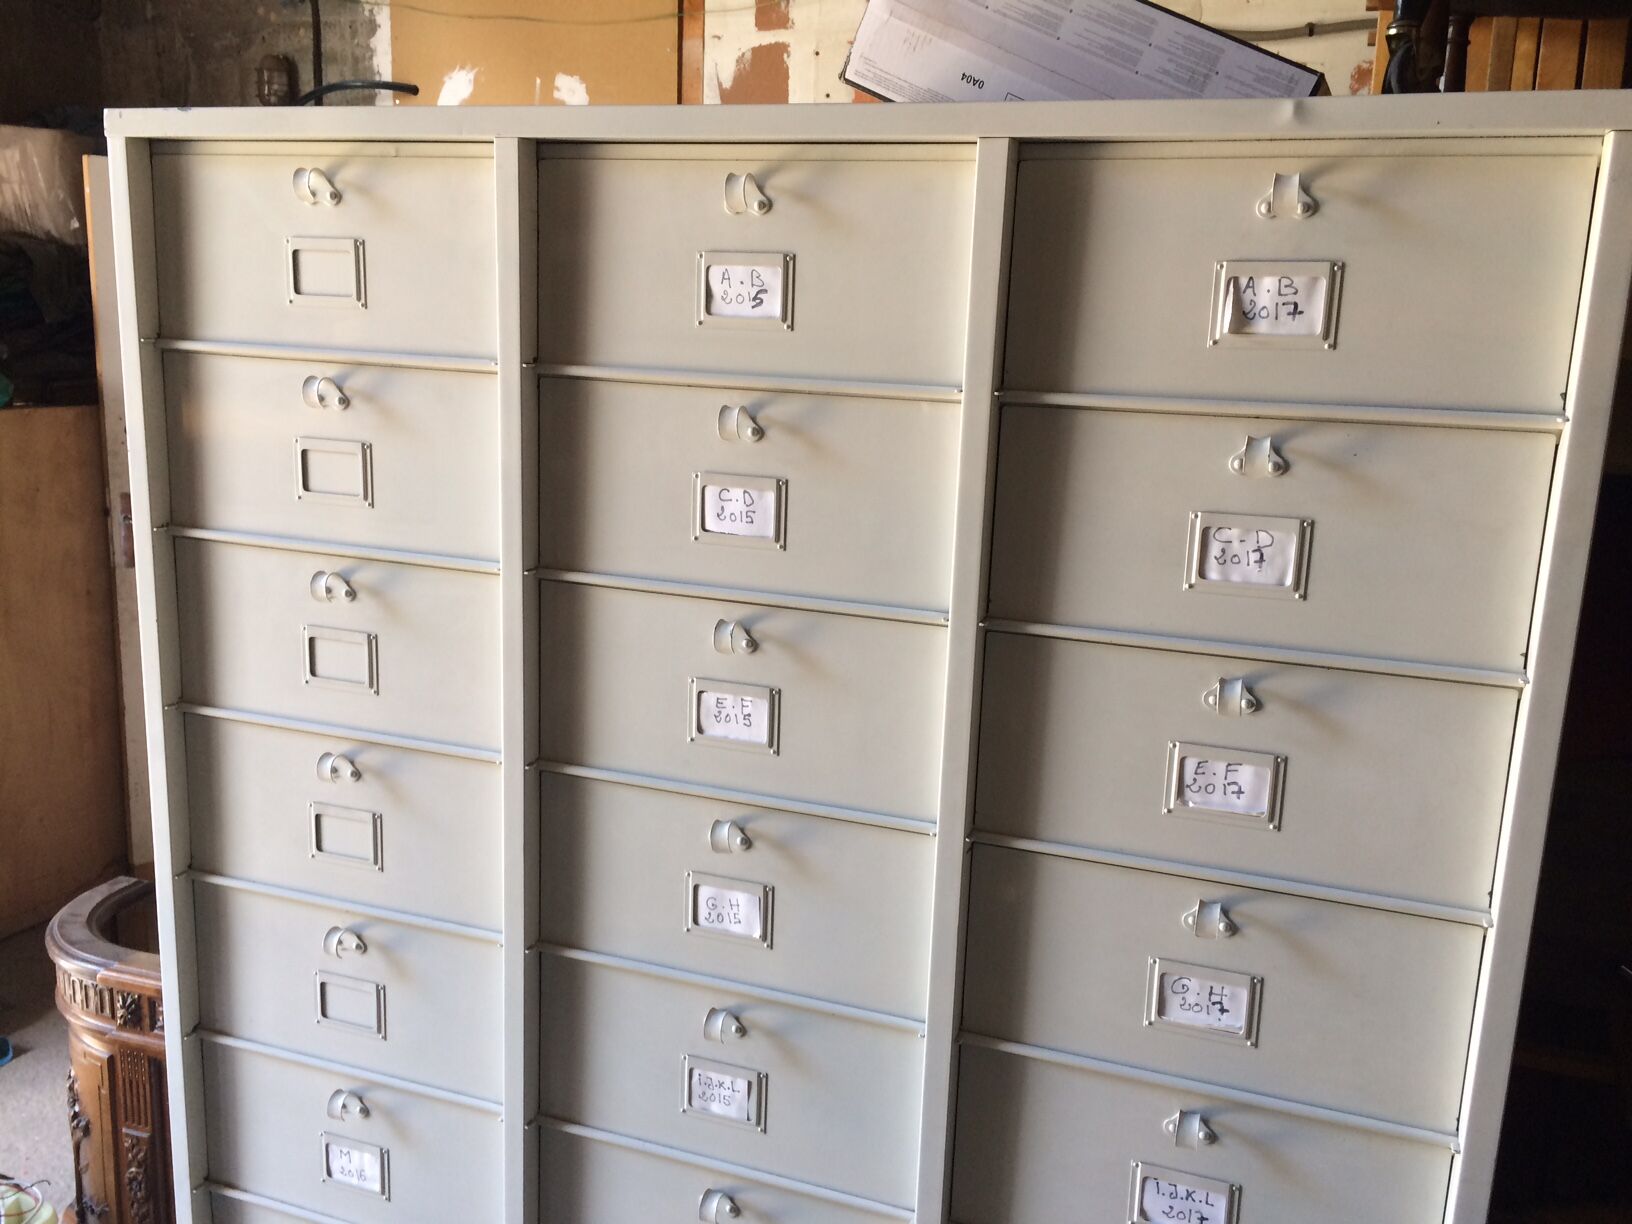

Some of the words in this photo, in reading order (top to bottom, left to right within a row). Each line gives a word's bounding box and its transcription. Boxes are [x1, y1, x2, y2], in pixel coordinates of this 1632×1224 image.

[720, 289, 769, 309] 2015
[1242, 299, 1304, 321] 2017
[716, 505, 756, 524] 2015
[1214, 547, 1266, 572] 2017
[713, 710, 752, 727] 2015
[1185, 777, 1245, 800] 2017
[704, 912, 742, 925] 2015
[1180, 996, 1230, 1017] 2017
[698, 1091, 731, 1107] 2015
[339, 1149, 352, 1164] M
[1162, 1205, 1209, 1224] 2017
